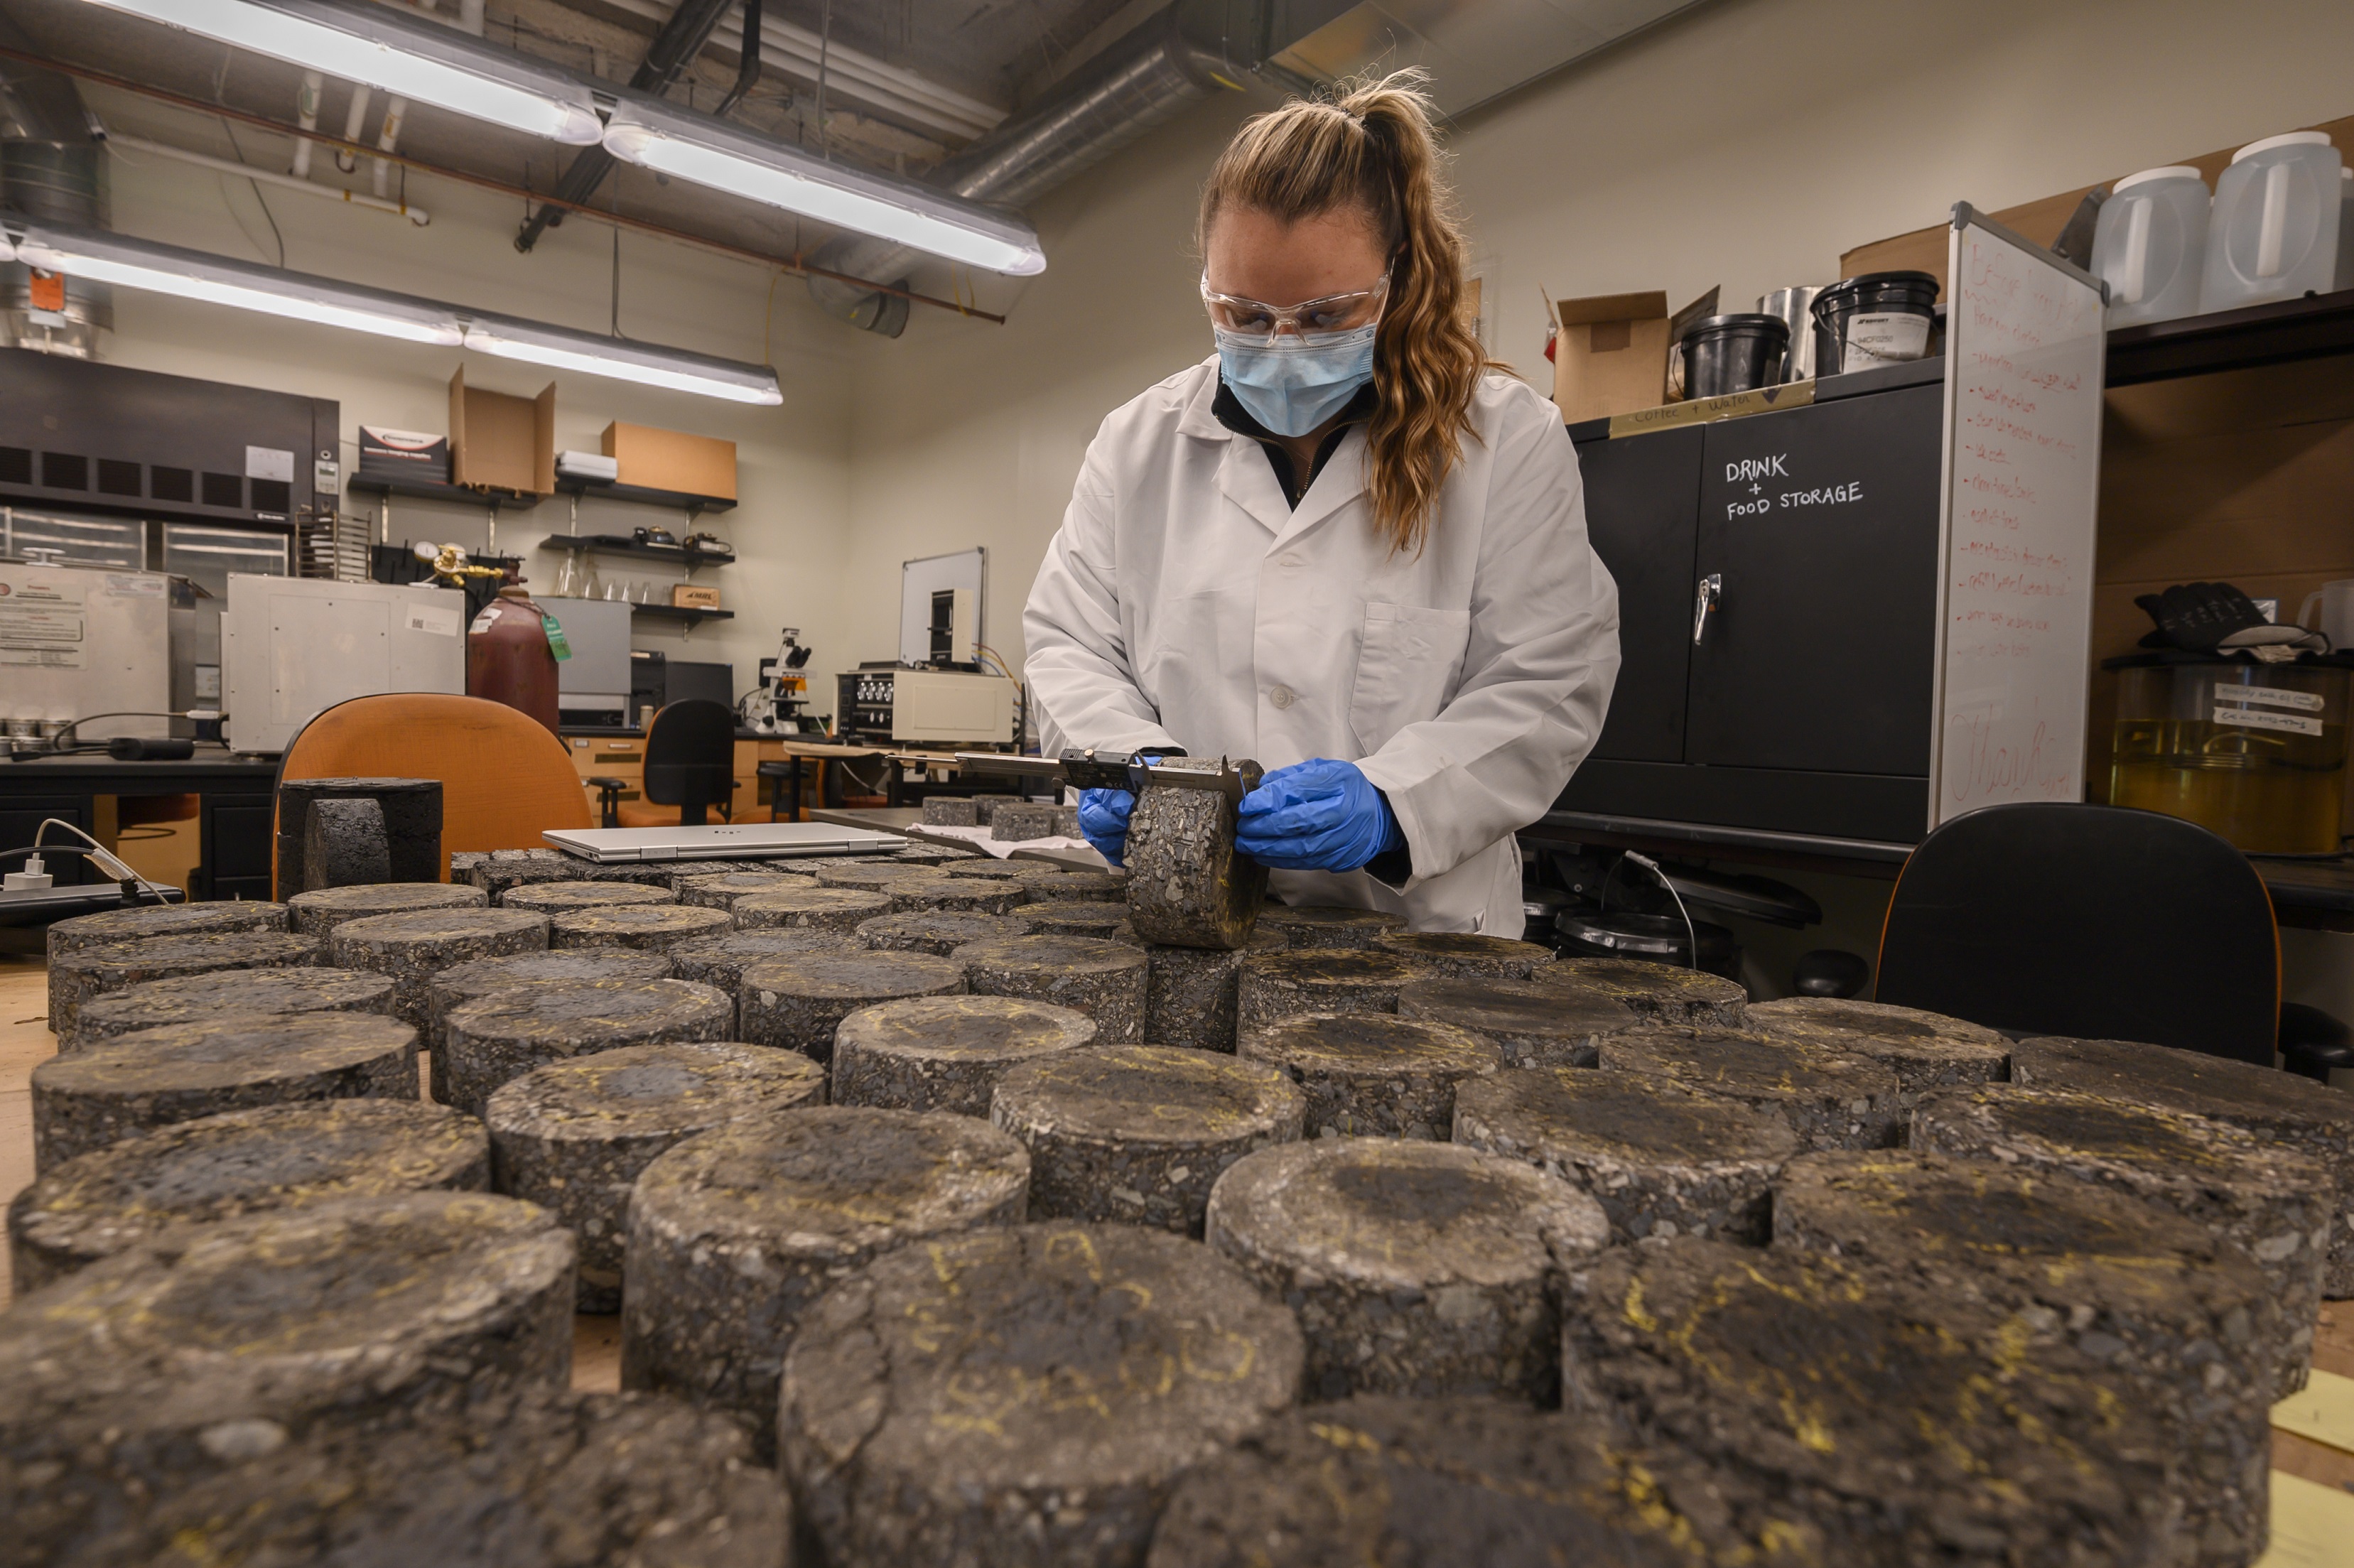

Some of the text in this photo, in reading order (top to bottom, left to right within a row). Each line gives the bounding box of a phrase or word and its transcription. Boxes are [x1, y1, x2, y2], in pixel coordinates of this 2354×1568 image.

[1692, 404, 1698, 414] +
[1726, 453, 1789, 482] DRINK
[1749, 483, 1762, 495] +
[1780, 481, 1864, 508] STORAGE
